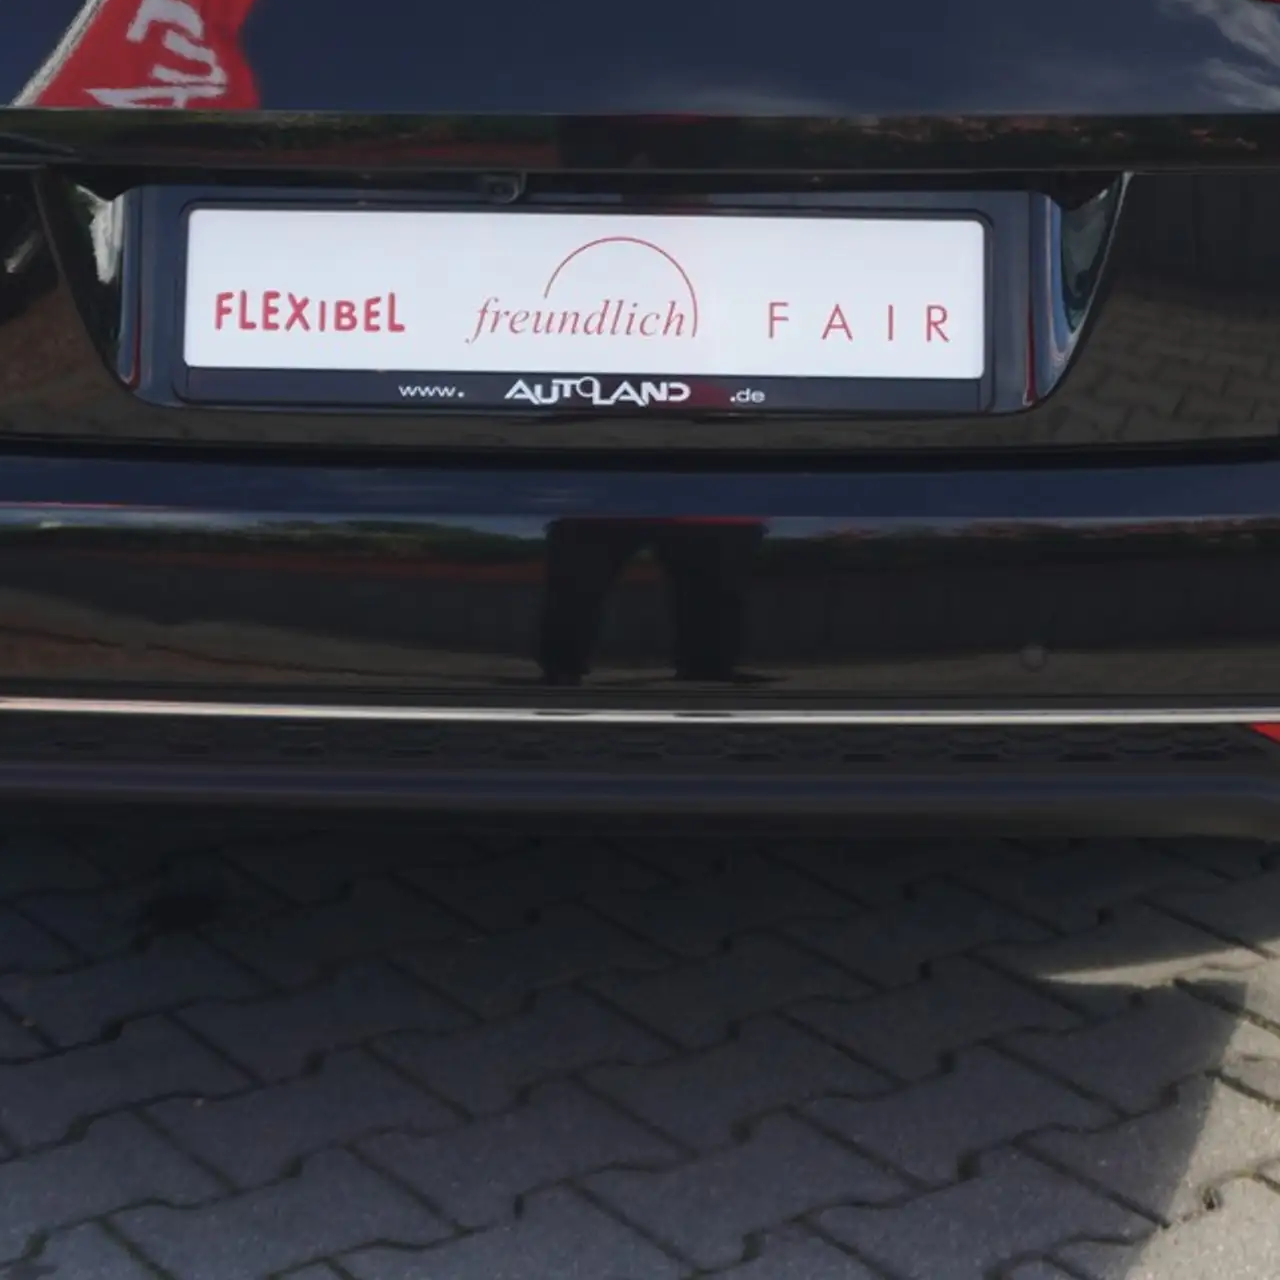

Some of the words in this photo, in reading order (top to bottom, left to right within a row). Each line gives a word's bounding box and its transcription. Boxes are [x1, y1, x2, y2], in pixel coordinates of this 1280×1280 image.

[213, 289, 406, 333] FLEXIBEL
[464, 296, 687, 345] freundlich
[767, 300, 951, 343] FAIR
[397, 382, 466, 399] www.
[504, 375, 692, 407] AUTOLAND
[729, 386, 766, 404] .de
